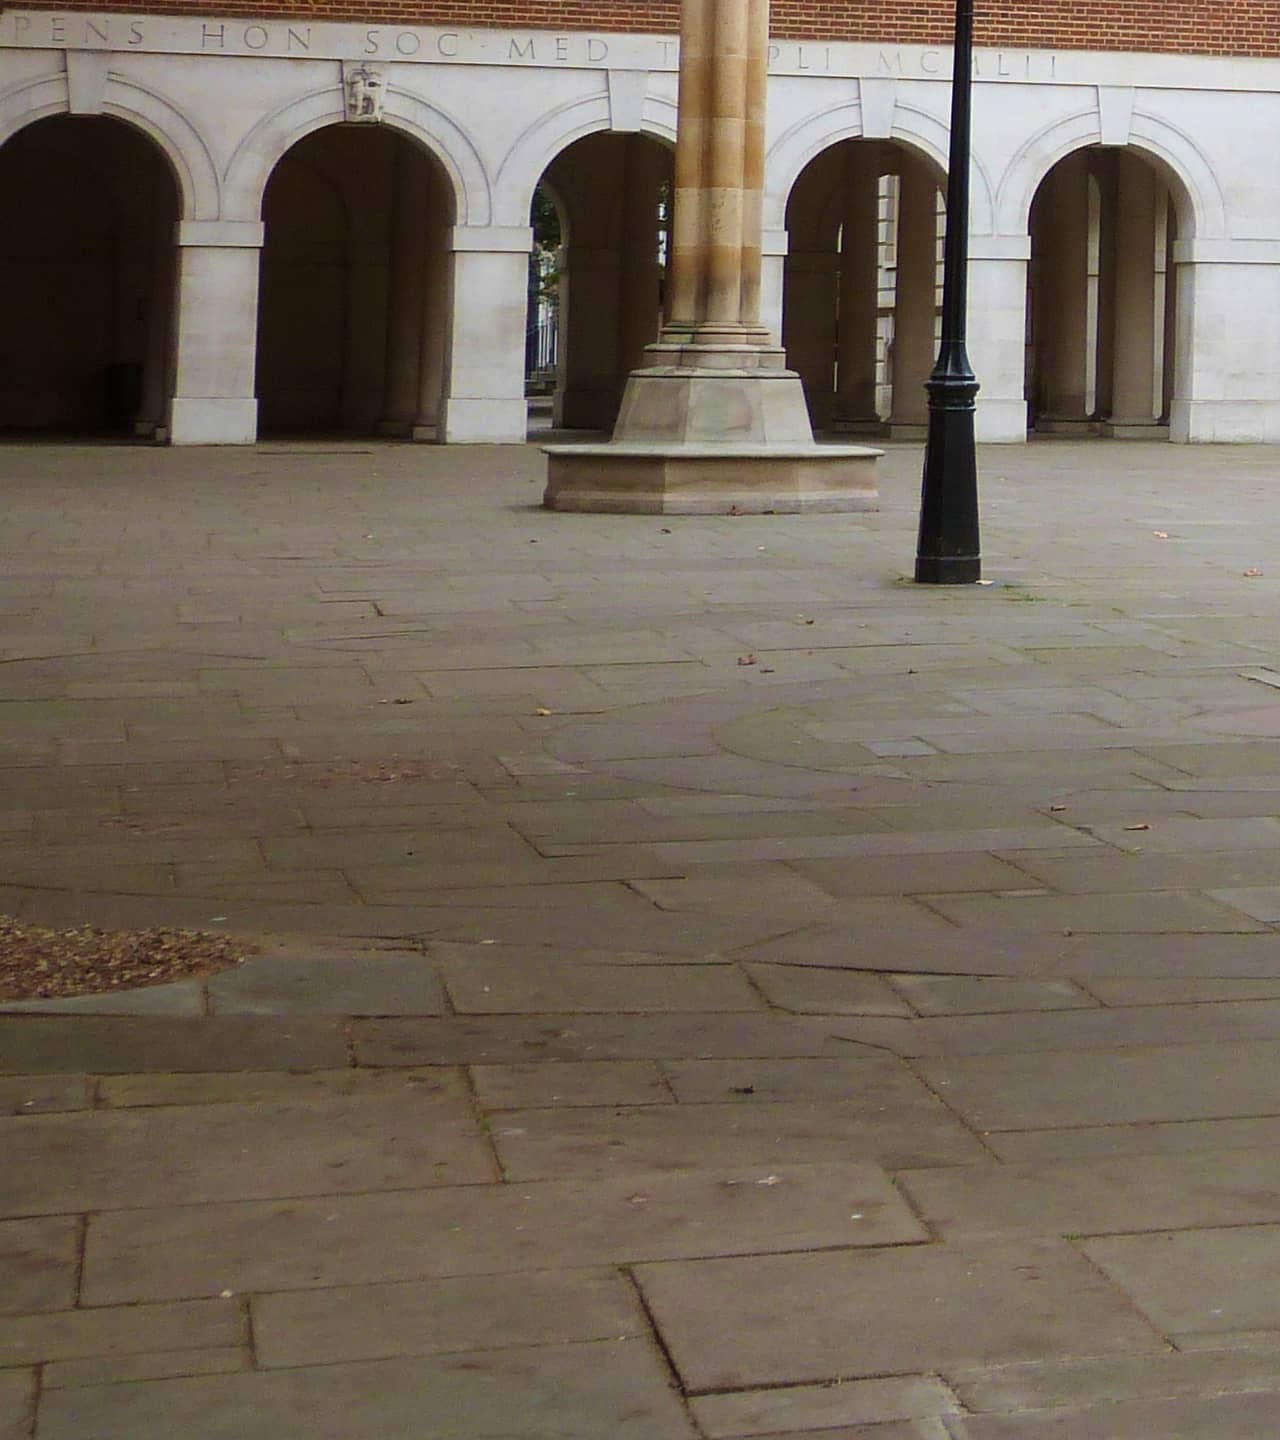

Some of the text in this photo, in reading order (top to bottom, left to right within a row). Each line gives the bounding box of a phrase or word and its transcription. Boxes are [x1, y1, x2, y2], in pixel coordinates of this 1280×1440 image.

[15, 15, 145, 45] PENS
[201, 23, 312, 51] HON
[508, 37, 609, 62] MED
[656, 40, 830, 71] TPLI
[876, 49, 1057, 78] MCLII
